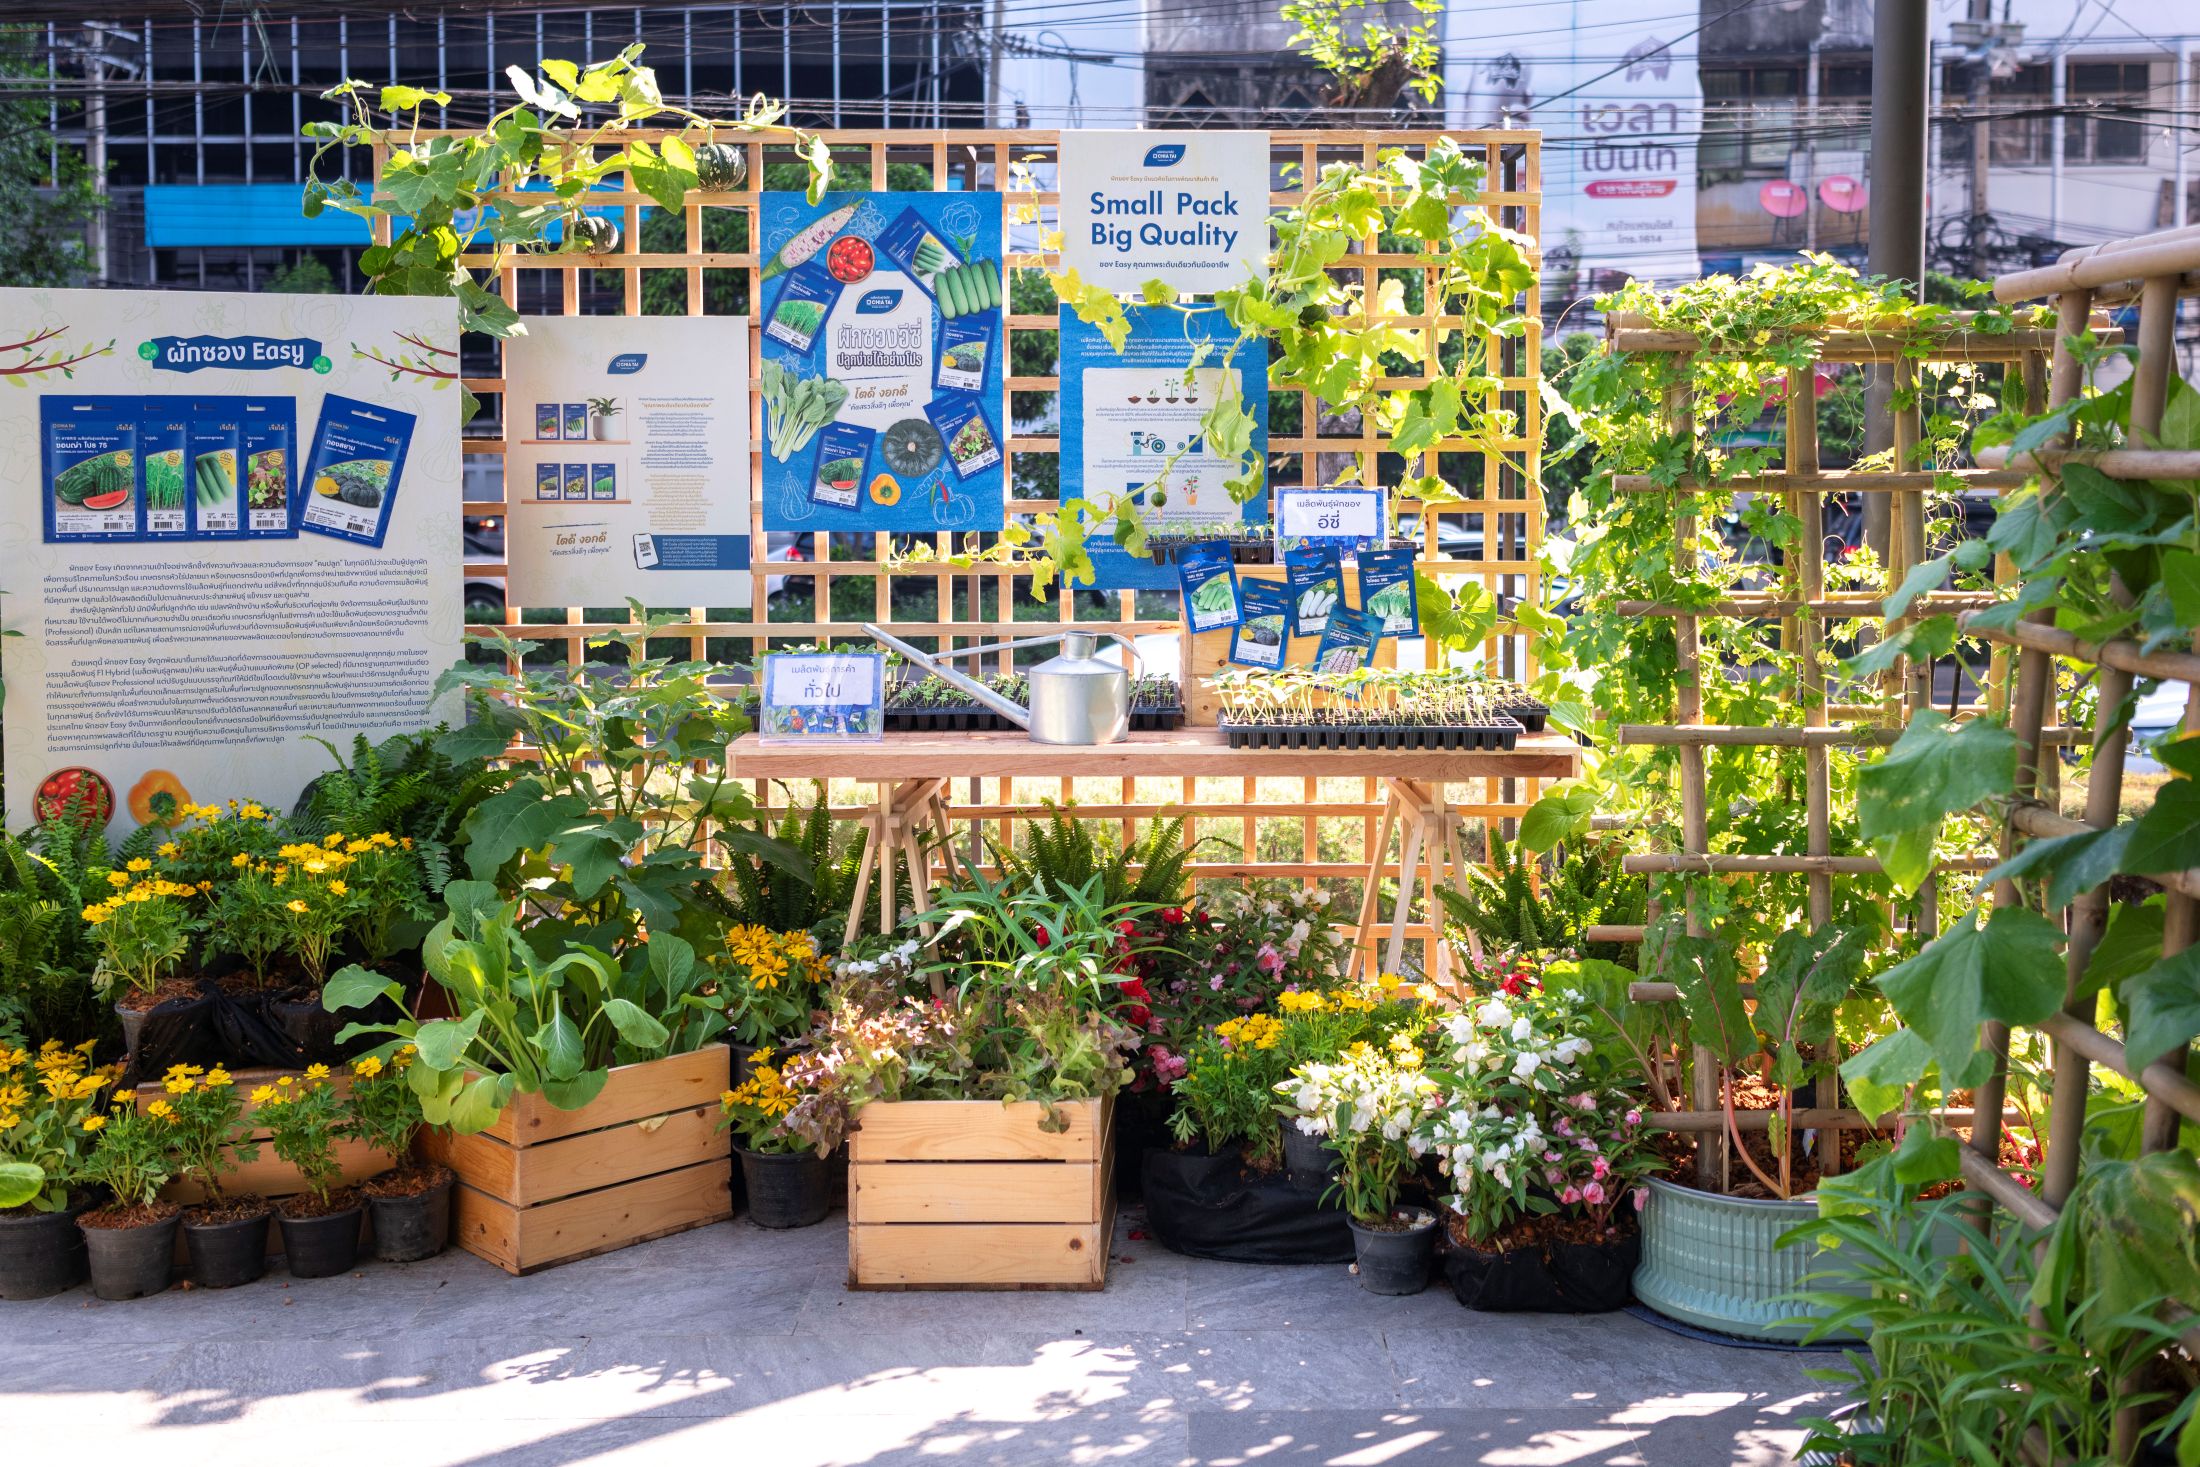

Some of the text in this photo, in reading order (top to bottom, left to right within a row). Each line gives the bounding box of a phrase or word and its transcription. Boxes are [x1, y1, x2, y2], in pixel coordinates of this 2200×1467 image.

[1583, 103, 1677, 133] เวลา
[1091, 190, 1239, 215] Small Pack
[1091, 222, 1238, 253] Big Quality
[1115, 261, 1132, 269] Easy
[837, 317, 922, 349] ผักซองอีซี่
[167, 341, 304, 367] ผักซอง Easy
[837, 350, 922, 370] ปลูกง่ายได้อย่างโปร
[1296, 499, 1361, 510] เมล็ดพันธุ์ผักซอง
[1318, 510, 1341, 529] อีซี่
[95, 564, 111, 572] Easy
[79, 584, 129, 593] ปริมาณการปลูก
[45, 627, 93, 636] (Professional)
[106, 668, 130, 676] Hybrid
[296, 662, 309, 670] (OP
[311, 661, 340, 670] selected)
[130, 657, 145, 665] Easy
[804, 679, 841, 698] ทั่วไป
[110, 721, 126, 729] Easy
